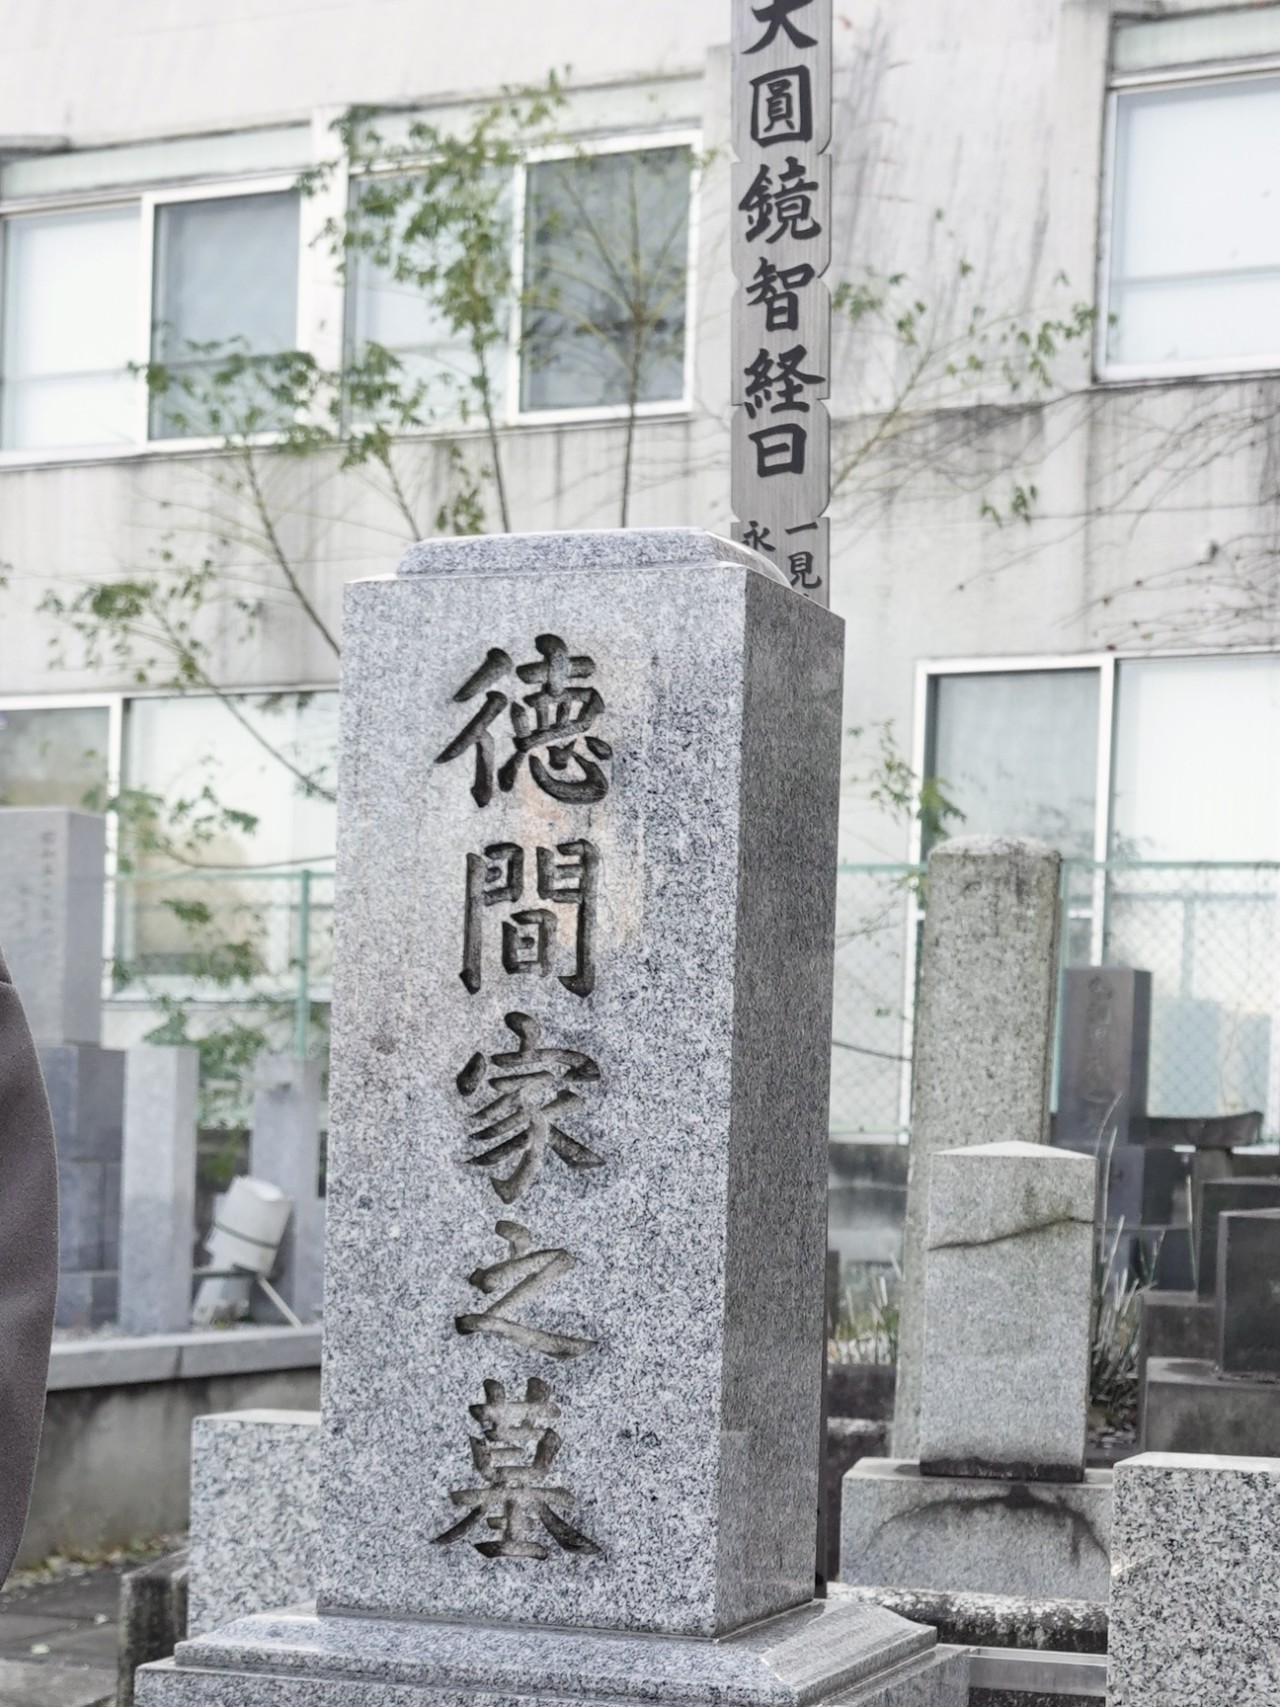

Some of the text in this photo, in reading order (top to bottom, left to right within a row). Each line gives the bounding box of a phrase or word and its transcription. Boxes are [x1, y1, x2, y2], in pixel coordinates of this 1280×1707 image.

[741, 520, 777, 552] 永
[784, 521, 823, 597] 一見
[429, 633, 614, 1561] 徳間家之墓
